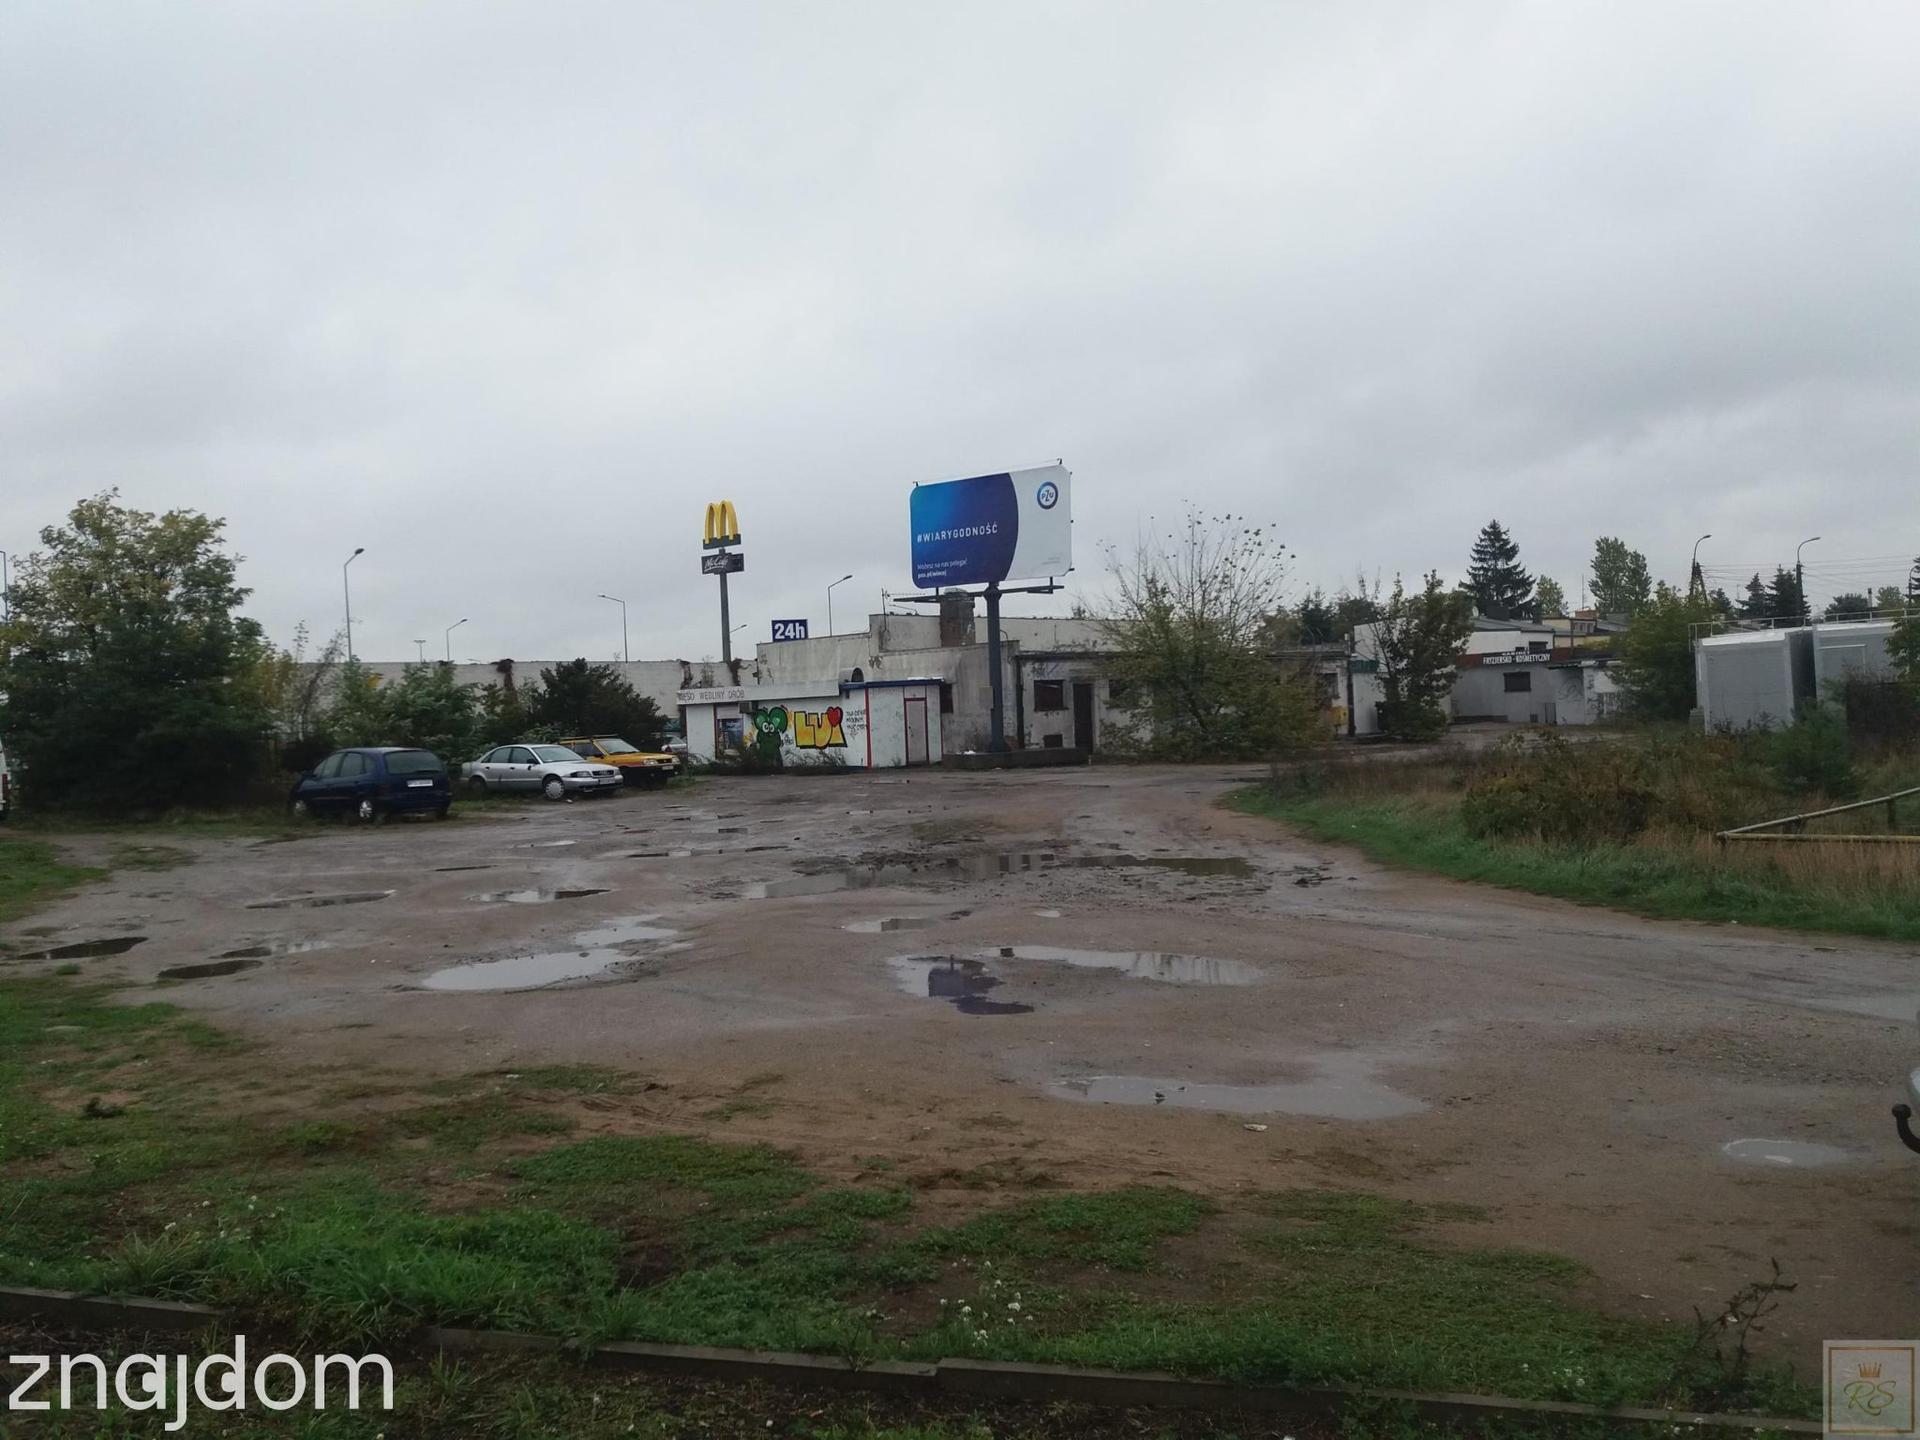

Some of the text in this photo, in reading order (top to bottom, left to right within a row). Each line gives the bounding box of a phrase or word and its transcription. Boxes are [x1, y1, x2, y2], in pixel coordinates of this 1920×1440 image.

[1041, 489, 1055, 502] PZU
[917, 521, 998, 543] #WIARYGODNOŚĆ
[774, 622, 806, 640] 24h
